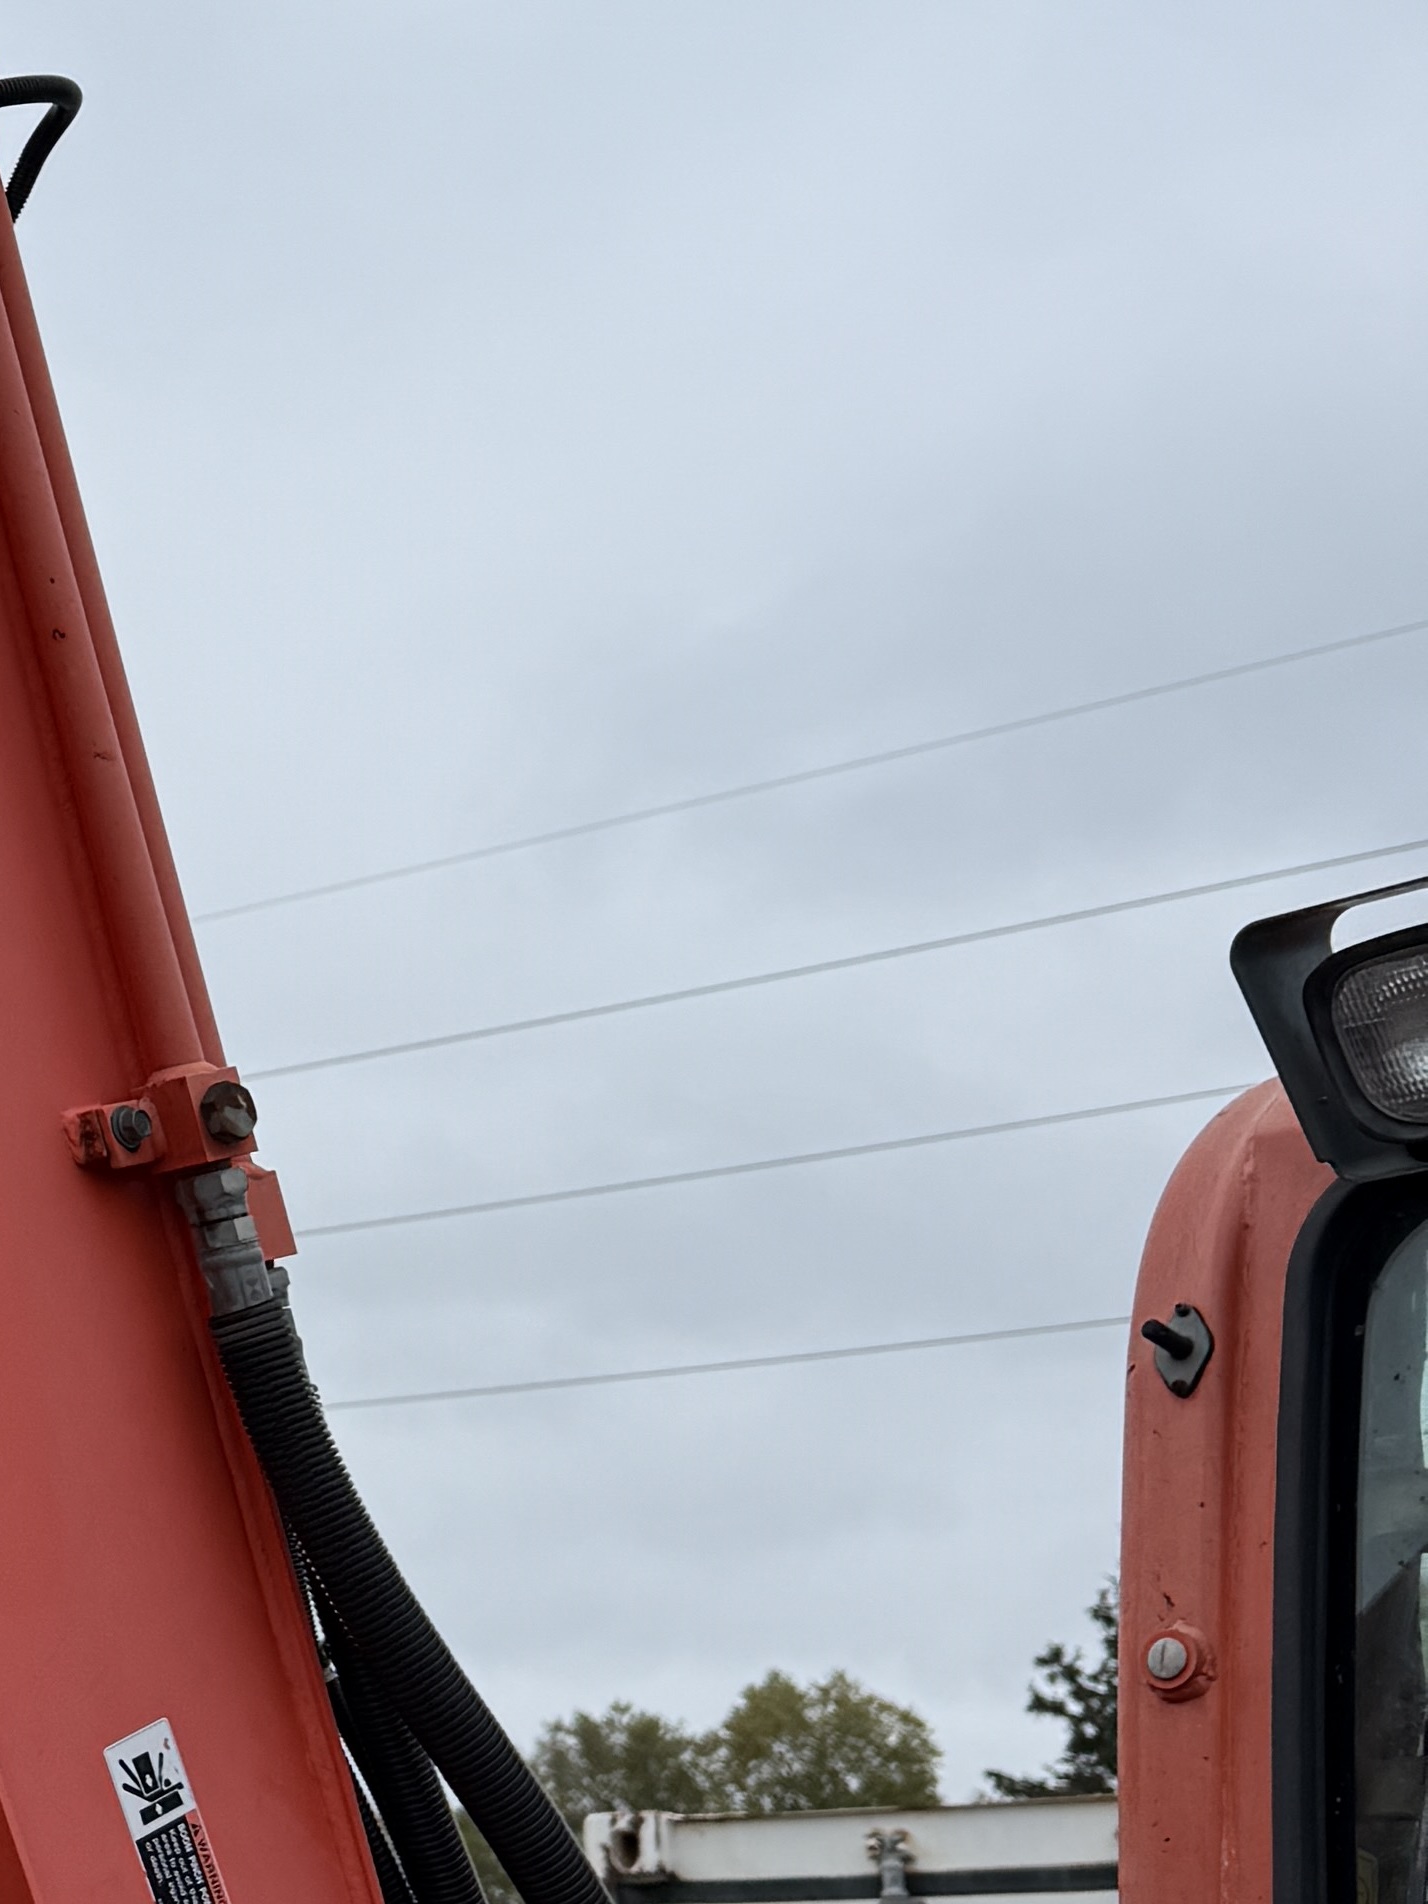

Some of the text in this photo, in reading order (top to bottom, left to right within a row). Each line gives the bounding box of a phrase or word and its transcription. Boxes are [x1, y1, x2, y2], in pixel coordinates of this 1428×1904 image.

[145, 1842, 154, 1853] or
[152, 1837, 173, 1879] personal
[160, 1833, 172, 1856] area
[169, 1857, 176, 1868] to
[173, 1870, 187, 1896] avoid
[168, 1828, 182, 1855] Keep
[178, 1857, 189, 1874] out
[184, 1875, 193, 1885] of
[177, 1823, 194, 1853] BOOM
[188, 1855, 205, 1885] PINCH
